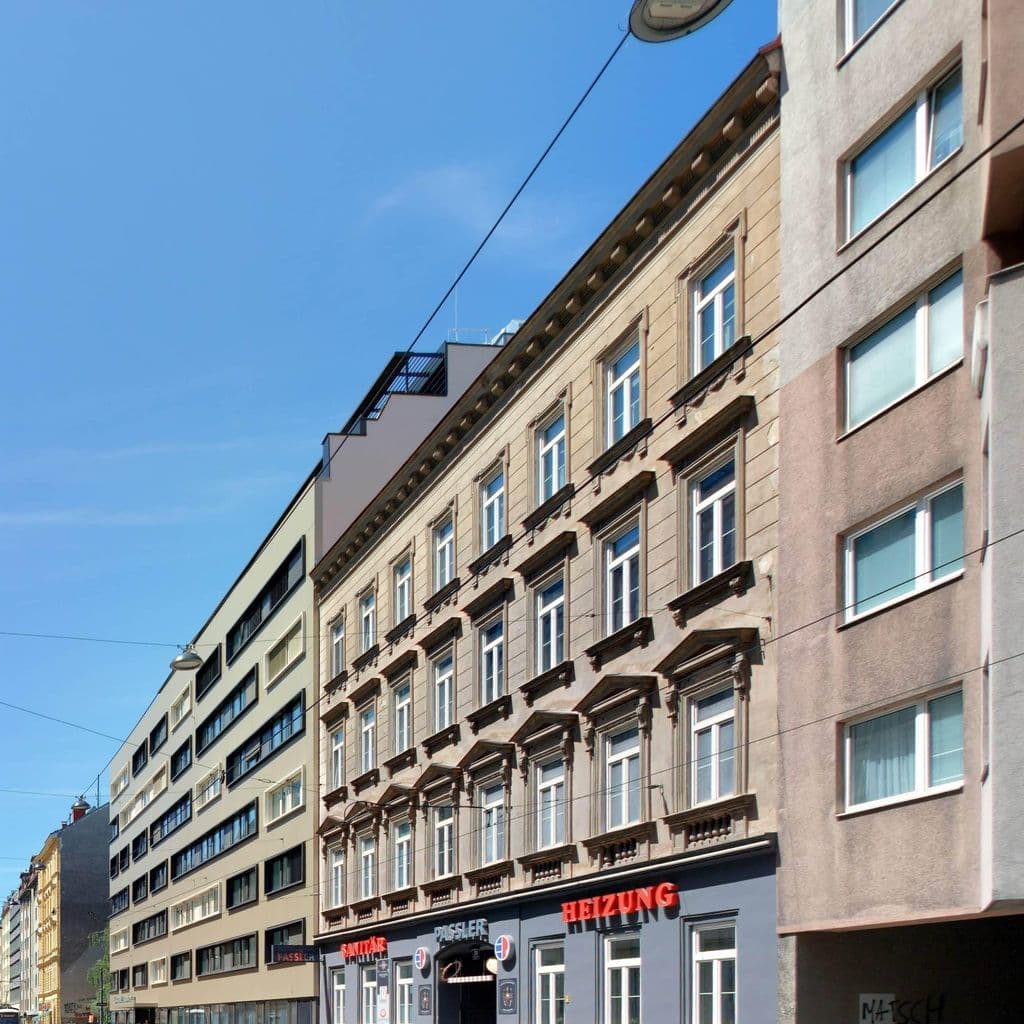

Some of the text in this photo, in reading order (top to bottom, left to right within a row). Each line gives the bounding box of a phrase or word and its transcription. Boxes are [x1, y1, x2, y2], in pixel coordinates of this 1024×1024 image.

[560, 882, 679, 924] HEIZUNG
[434, 919, 489, 943] PASSLER
[340, 936, 388, 959] SANITÄR
